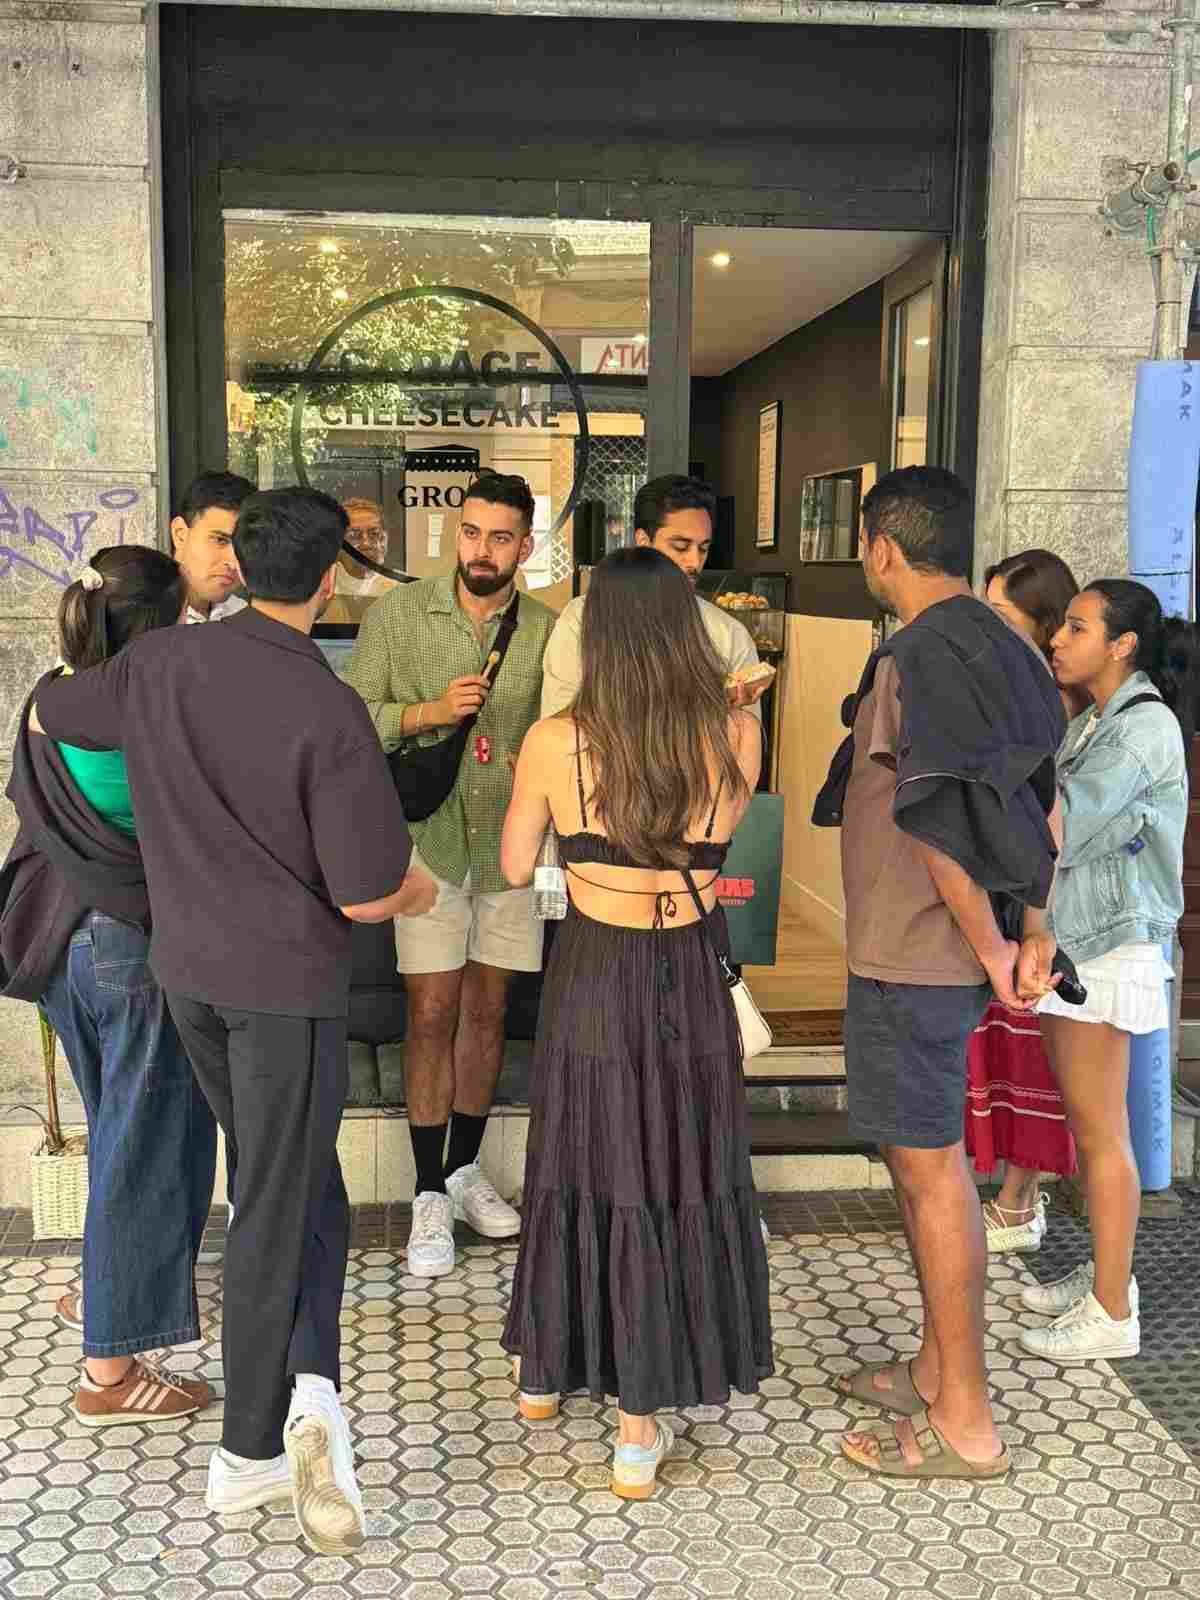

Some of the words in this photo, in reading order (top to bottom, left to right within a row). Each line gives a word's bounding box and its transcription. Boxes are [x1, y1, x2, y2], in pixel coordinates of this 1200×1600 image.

[338, 350, 542, 388] GRAGE
[319, 399, 561, 428] CHEESECAKE
[398, 485, 465, 508] GRO
